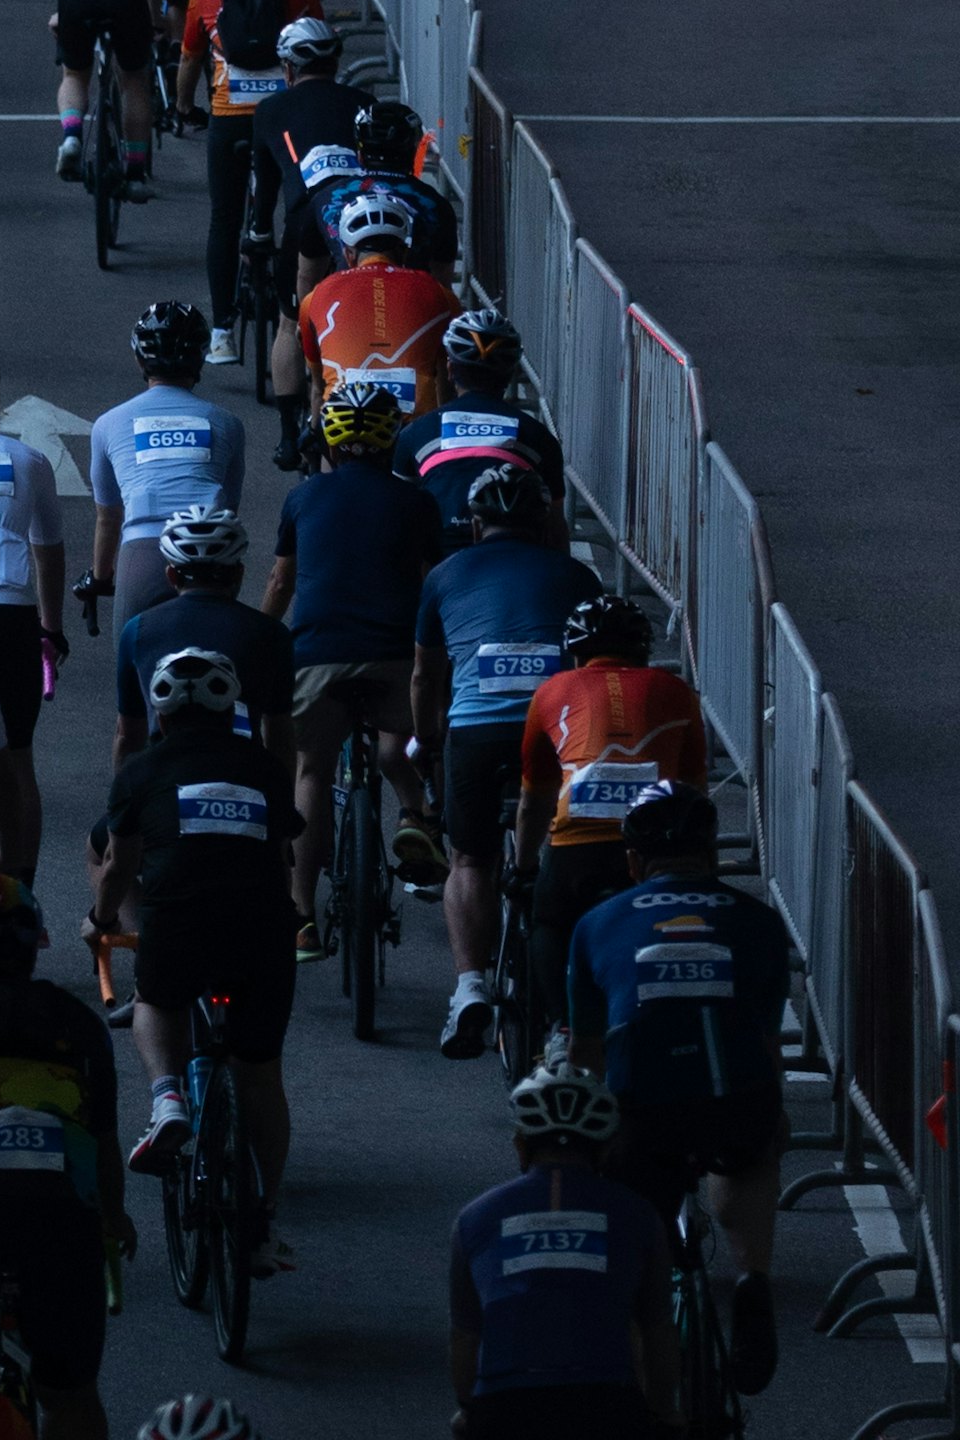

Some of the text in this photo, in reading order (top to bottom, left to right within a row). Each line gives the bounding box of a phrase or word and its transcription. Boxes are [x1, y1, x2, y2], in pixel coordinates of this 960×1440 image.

[239, 79, 279, 92] 6156
[311, 155, 350, 173] 6766
[455, 424, 504, 436] 6696
[148, 432, 197, 447] 6694
[493, 657, 546, 675] 6789
[196, 800, 251, 820] 7084
[654, 962, 715, 981] 7136
[521, 1232, 588, 1252] 7137
